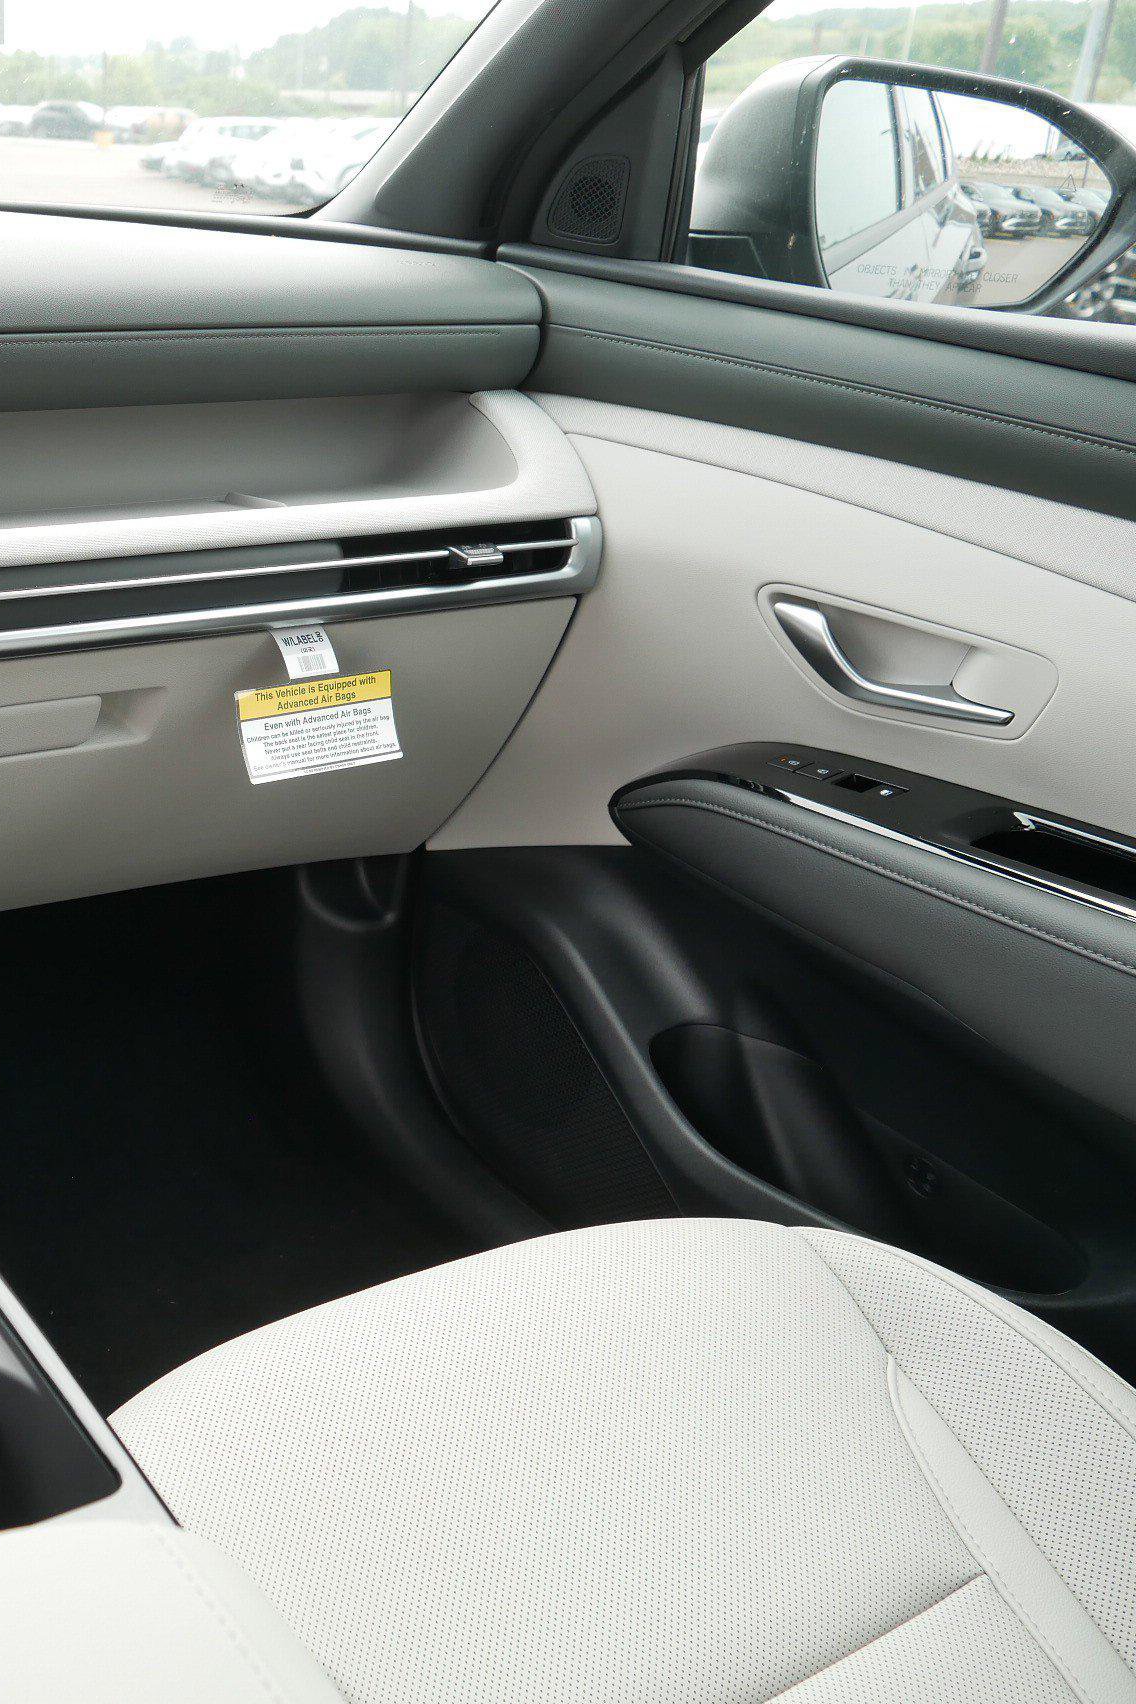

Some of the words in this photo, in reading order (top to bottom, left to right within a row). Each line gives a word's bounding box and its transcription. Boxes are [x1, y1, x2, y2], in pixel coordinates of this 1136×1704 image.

[858, 264, 896, 275] OBJECTS
[983, 271, 1019, 283] CLOSER
[888, 278, 911, 288] THAN
[945, 283, 982, 293] APEAR
[255, 692, 273, 702] This
[276, 686, 306, 699] Vehicle
[308, 685, 316, 694] is
[318, 678, 357, 692] Equipped
[359, 676, 376, 686] with
[277, 697, 318, 710] Advanced
[320, 694, 332, 704] Air
[336, 691, 356, 702] Bags
[264, 721, 283, 730] Even
[284, 718, 301, 726] with
[303, 712, 338, 725] Advanced
[340, 709, 351, 718] Air
[354, 706, 372, 716] Bags
[246, 734, 270, 743] Children
[312, 724, 336, 732] seriously
